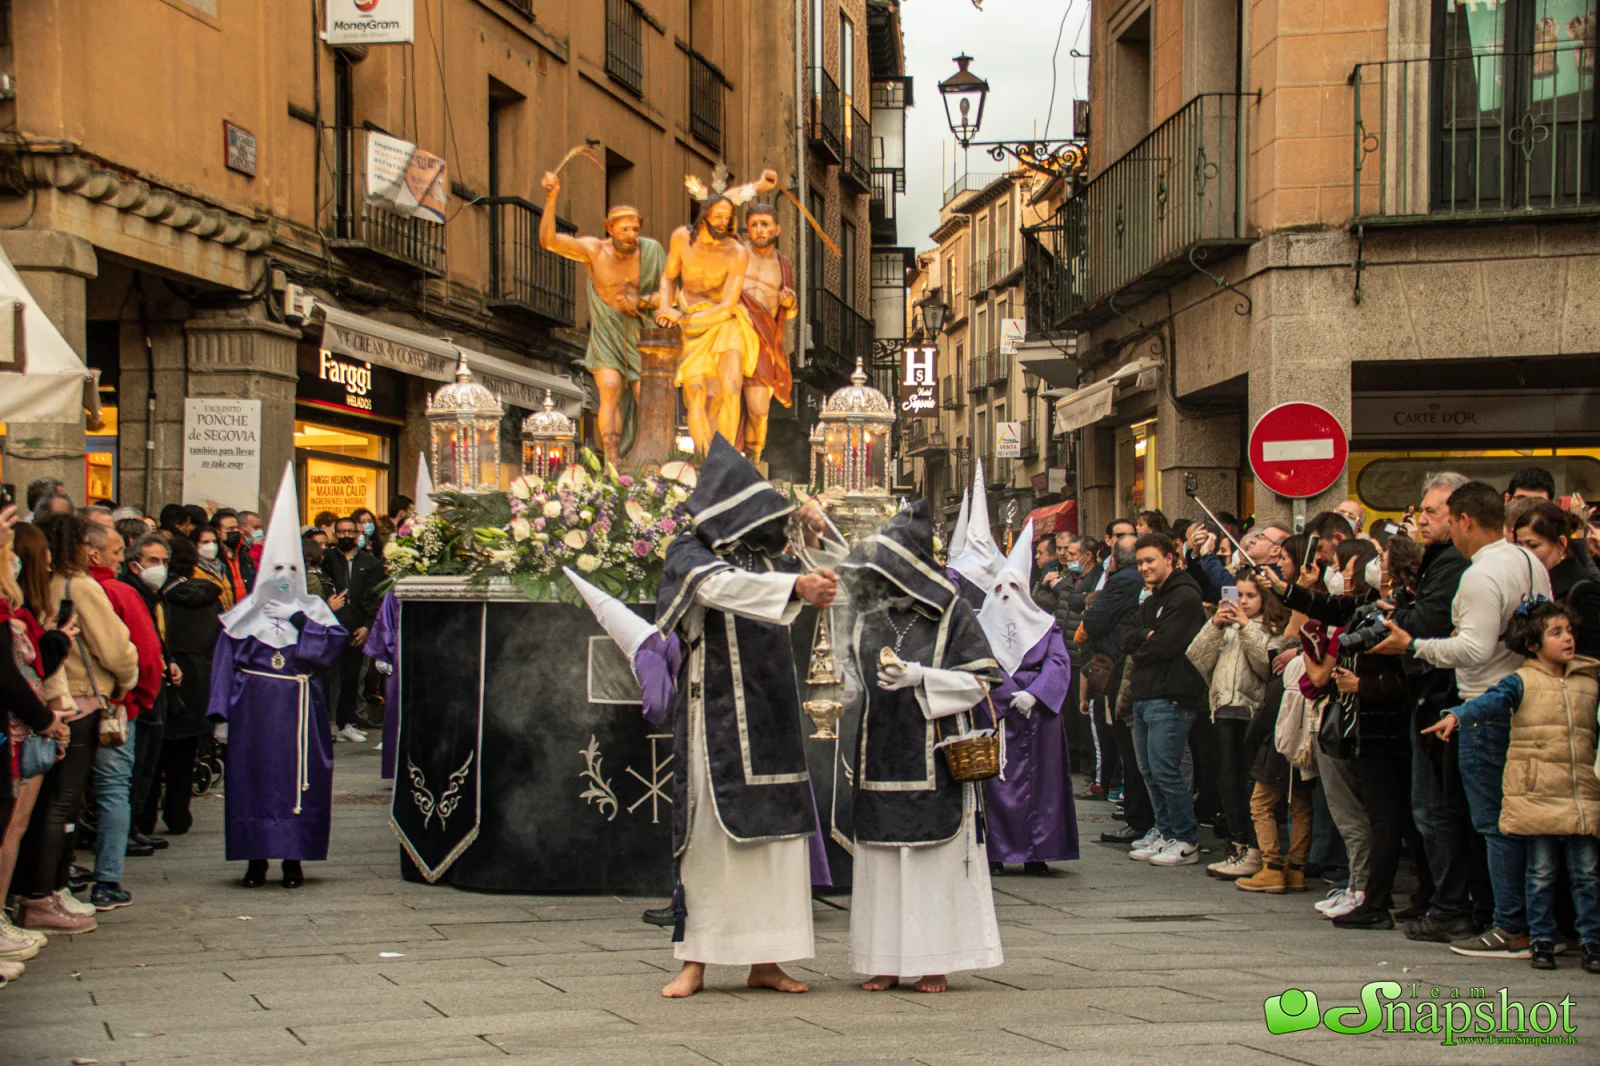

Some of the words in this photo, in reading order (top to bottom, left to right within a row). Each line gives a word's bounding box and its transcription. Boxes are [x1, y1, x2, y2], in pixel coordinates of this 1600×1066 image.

[334, 20, 399, 32] MoneyGram
[353, 334, 386, 357] CREAM
[319, 348, 372, 395] Farggi
[346, 394, 372, 411] HELADOS
[902, 394, 936, 414] Segovia
[204, 405, 242, 414] EXQUISITO
[197, 414, 249, 426] PONCHE
[1394, 411, 1437, 426] CARTE
[188, 427, 202, 441] de
[204, 429, 257, 442] SEGOVIA
[190, 446, 218, 455] también
[219, 448, 235, 457] para
[236, 447, 256, 456] llevar
[212, 459, 226, 468] take
[227, 461, 245, 470] away
[310, 476, 329, 485] FARGGI
[330, 475, 354, 485] HELADOS
[316, 485, 344, 497] MAXIMA
